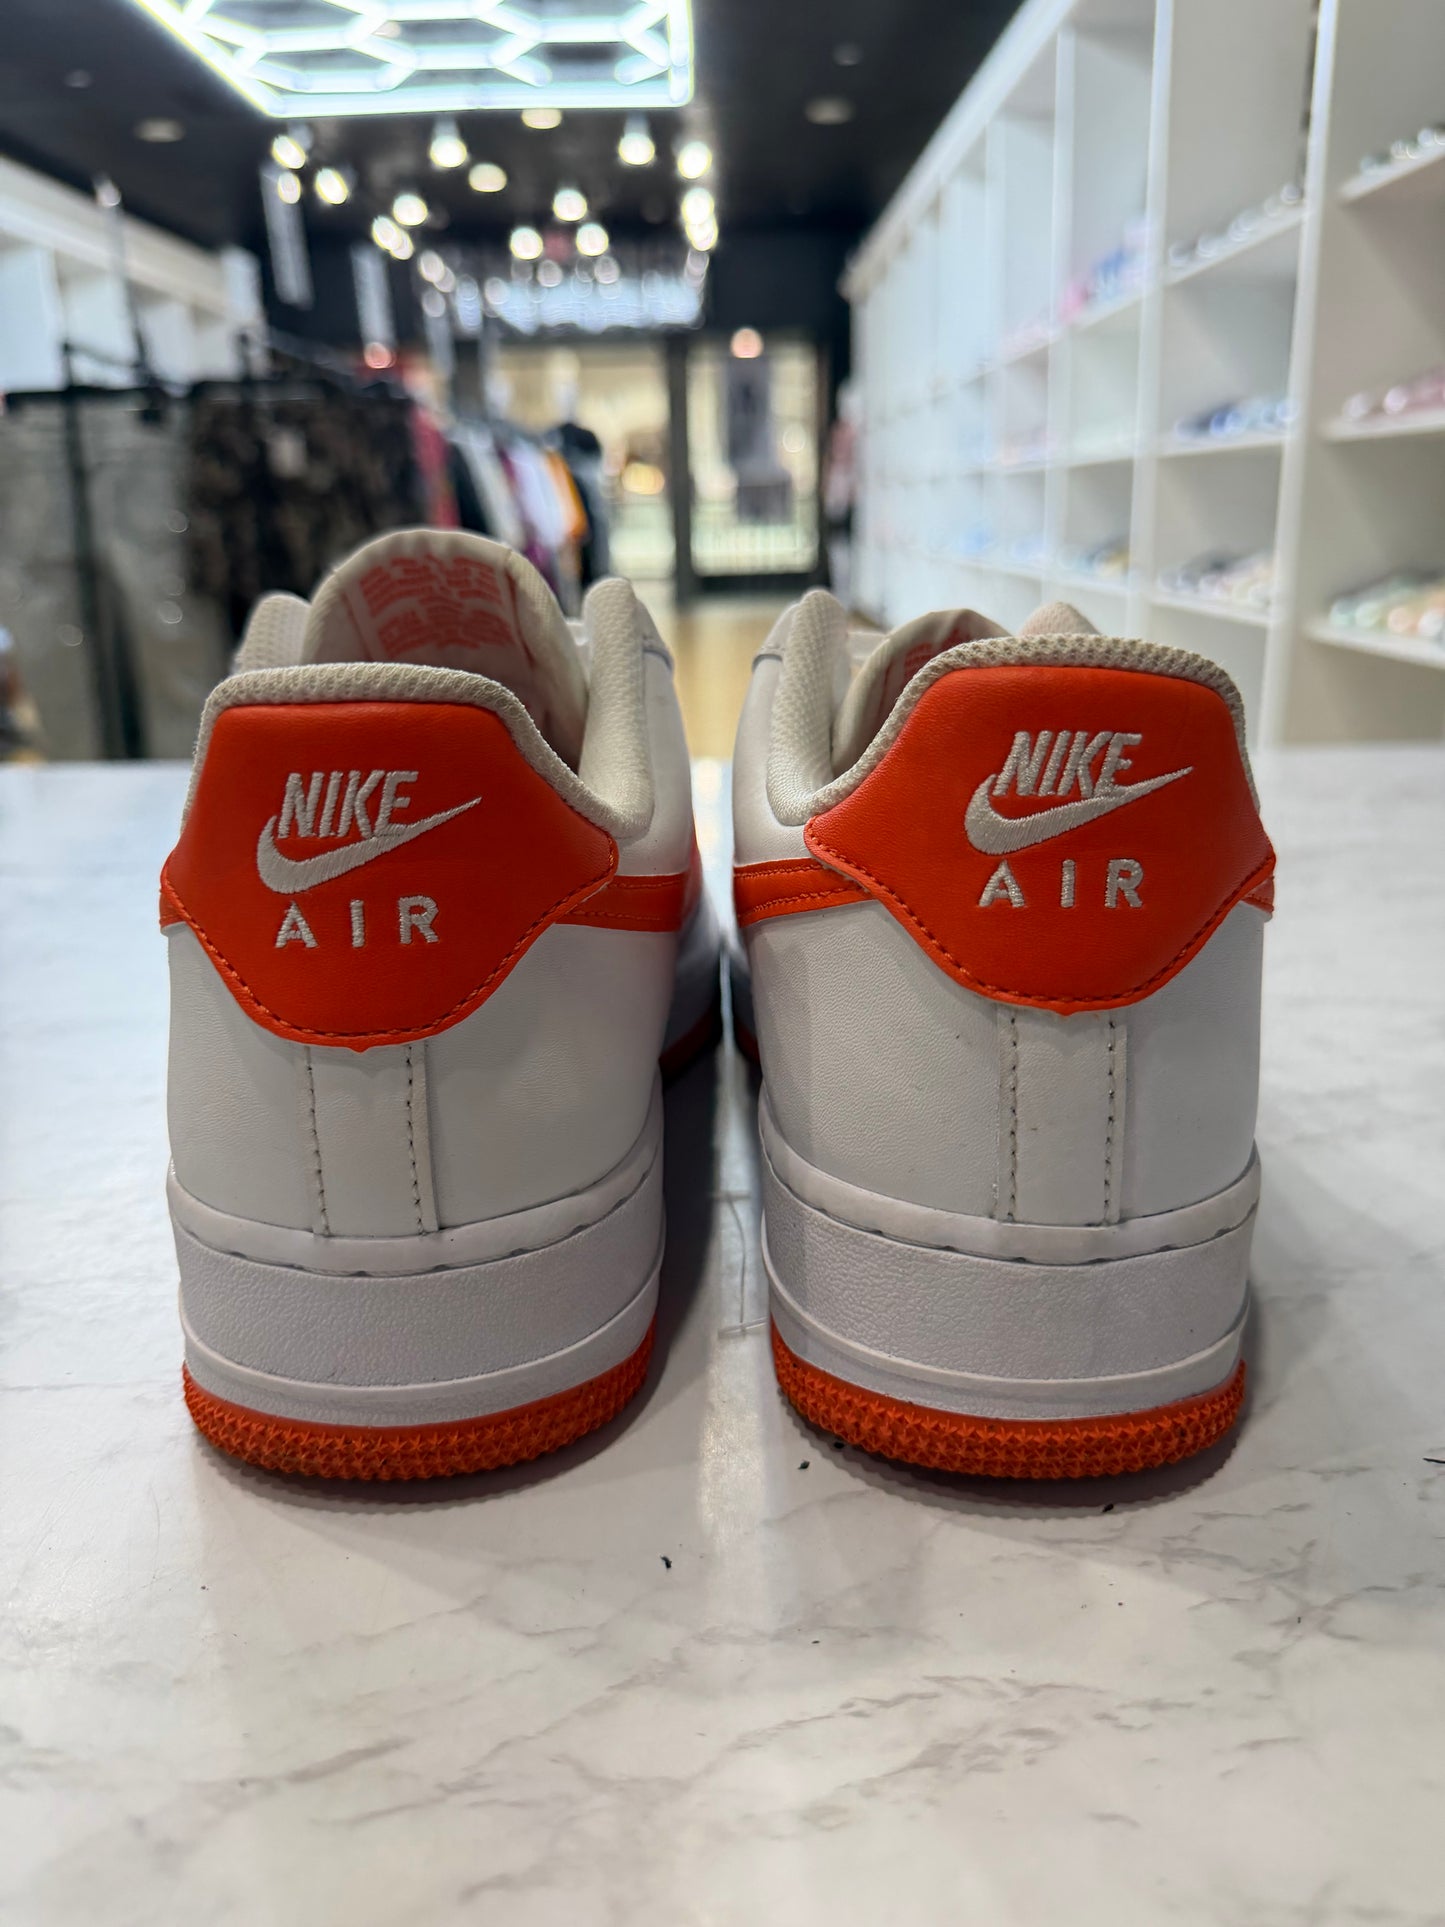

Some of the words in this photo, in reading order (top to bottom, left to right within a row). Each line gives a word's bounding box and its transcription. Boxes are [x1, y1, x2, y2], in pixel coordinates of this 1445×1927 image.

[991, 730, 1143, 797] NIKE
[277, 769, 419, 838] NIKE
[978, 858, 1144, 909] AIR
[274, 894, 440, 949] AIR
